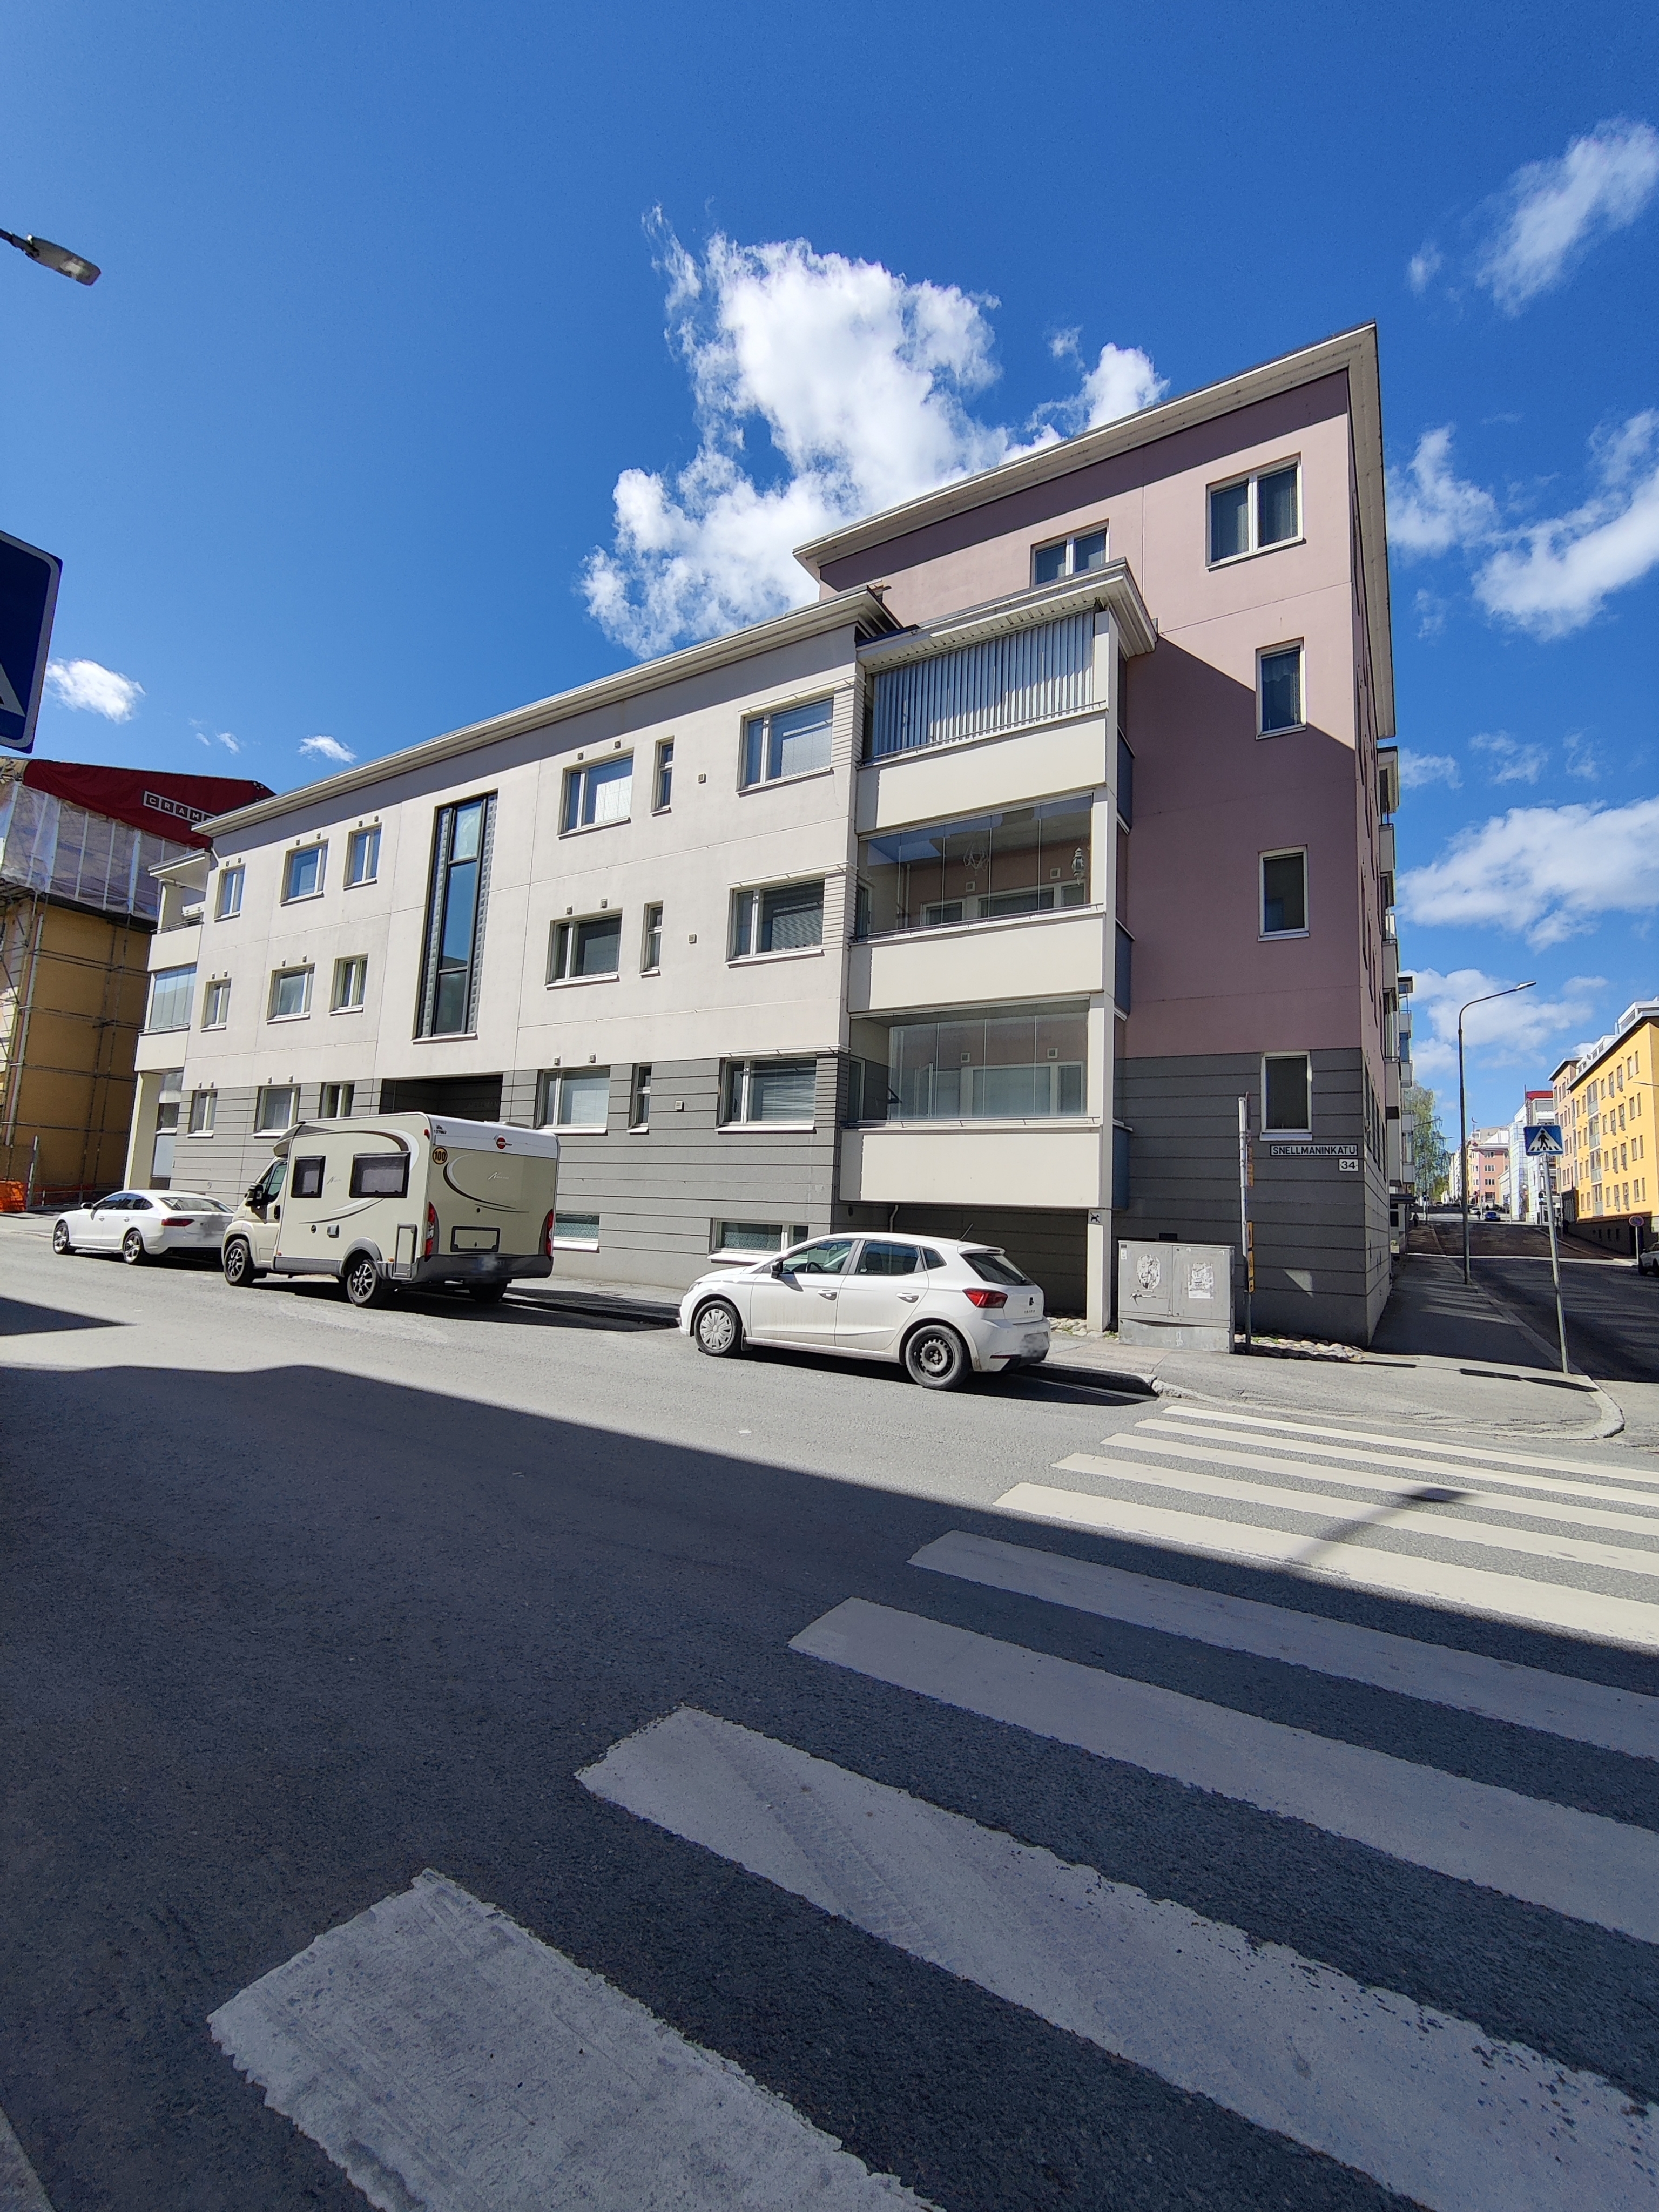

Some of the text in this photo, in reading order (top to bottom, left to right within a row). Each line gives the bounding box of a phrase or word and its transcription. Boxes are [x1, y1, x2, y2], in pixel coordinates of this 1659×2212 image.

[149, 797, 211, 821] CRAM
[1273, 1146, 1355, 1155] SNELLMANINKATU
[434, 1151, 446, 1161] 100
[1341, 1161, 1355, 1169] 34
